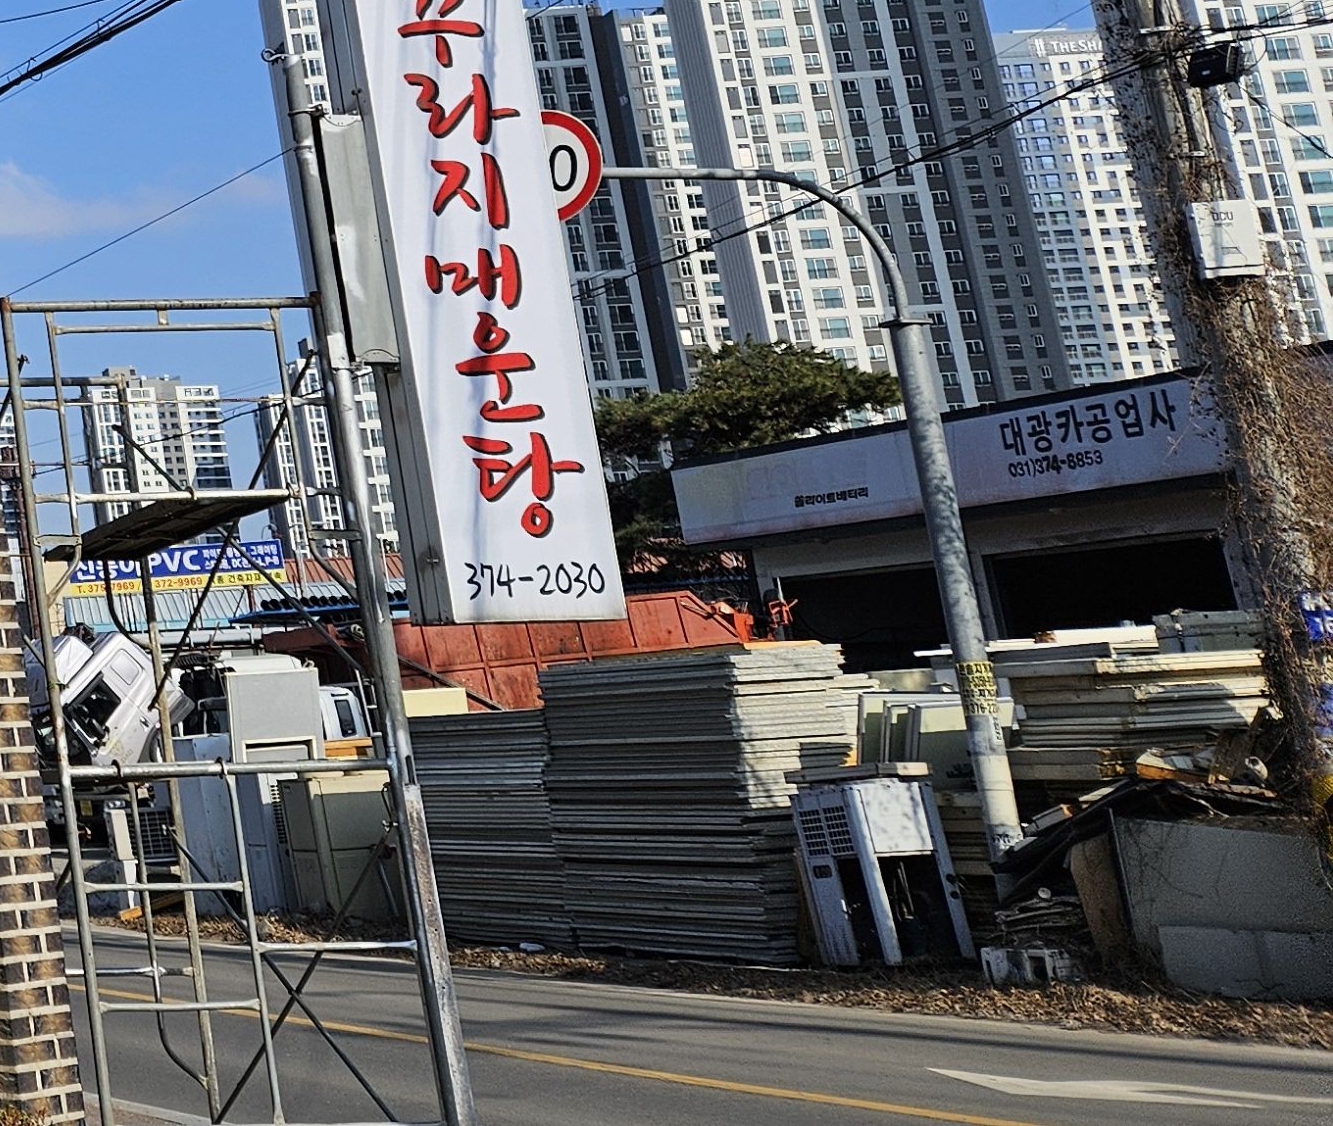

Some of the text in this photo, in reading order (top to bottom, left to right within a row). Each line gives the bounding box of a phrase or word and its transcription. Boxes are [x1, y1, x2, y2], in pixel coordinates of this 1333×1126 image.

[549, 144, 577, 192] 0
[999, 389, 1177, 456] 대광카공업사
[1008, 450, 1104, 478] 031)374-8853
[155, 577, 203, 588] 372-9969
[464, 562, 605, 600] 374-2030
